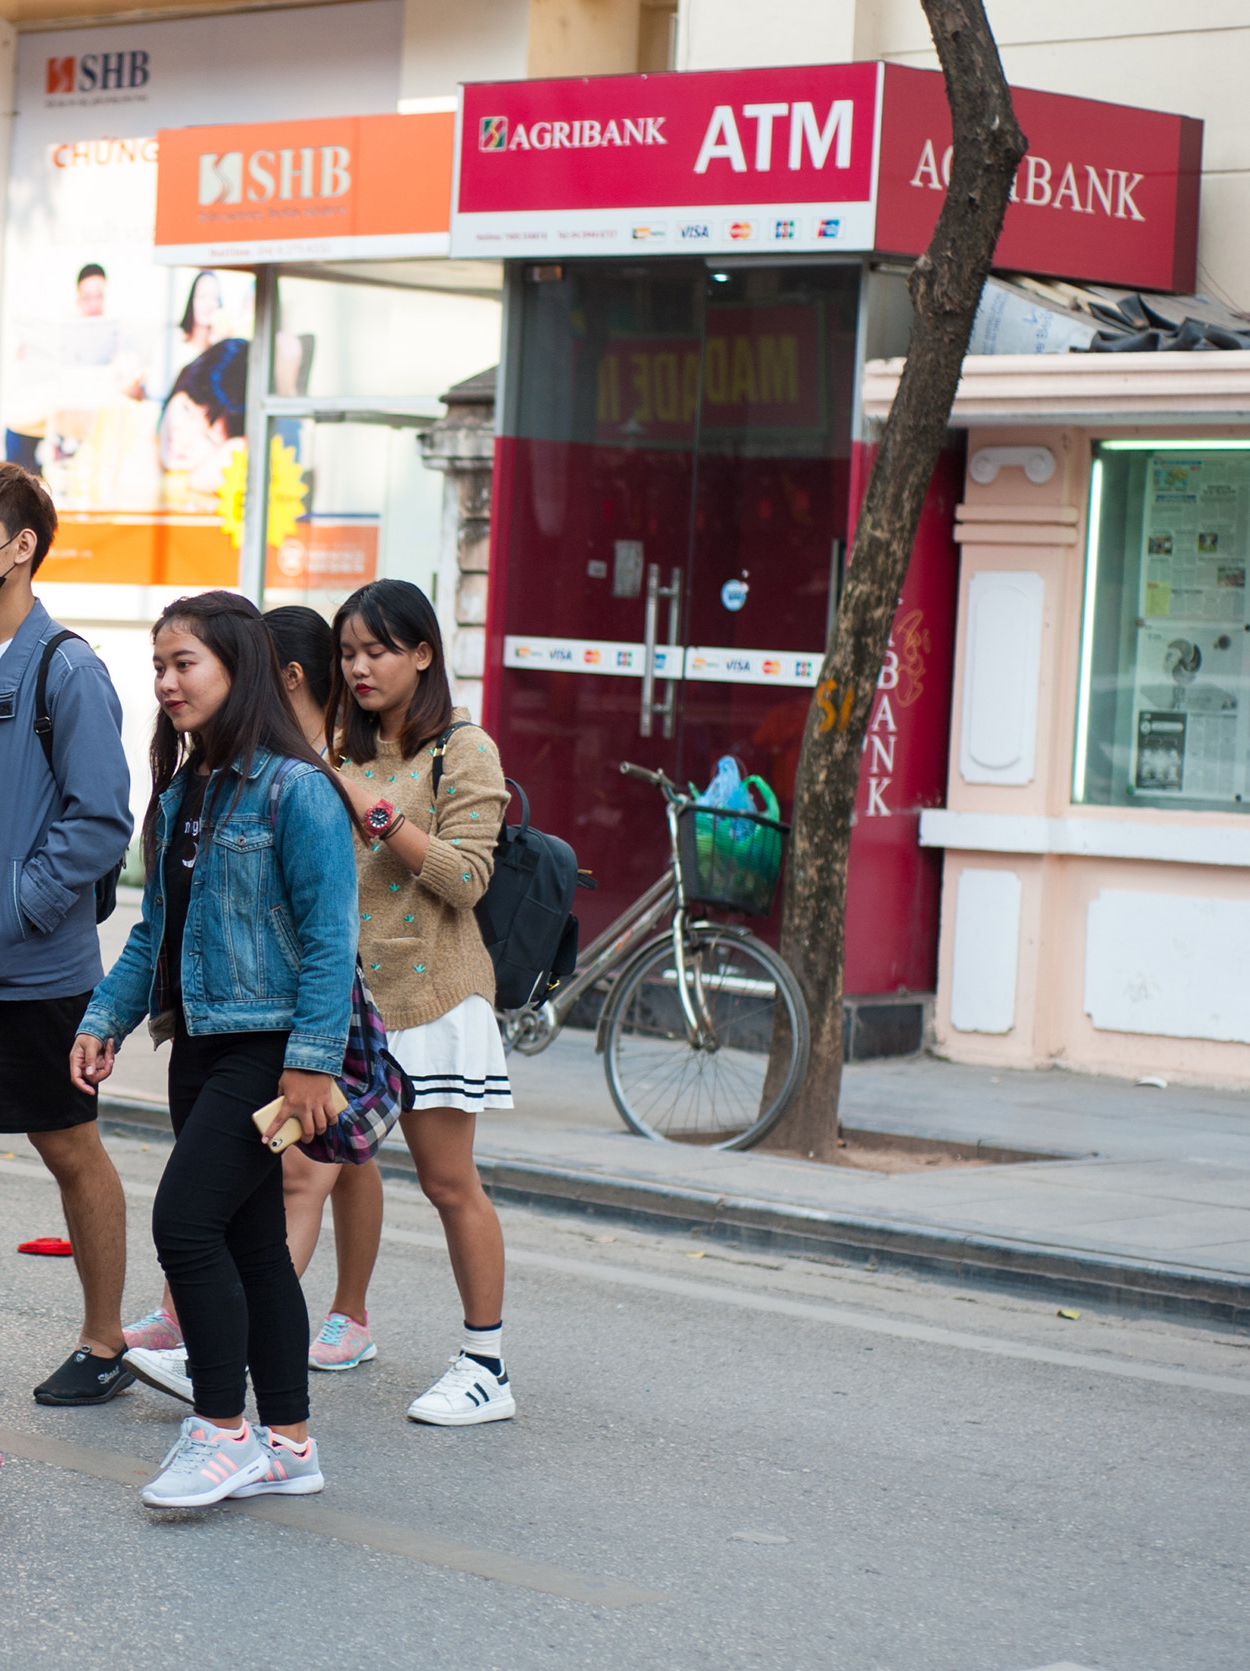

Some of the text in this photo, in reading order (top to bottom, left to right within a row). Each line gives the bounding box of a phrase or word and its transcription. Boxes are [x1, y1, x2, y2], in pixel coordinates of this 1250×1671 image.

[78, 50, 150, 92] SHB
[508, 117, 668, 150] AGRIBANK
[693, 99, 854, 175] ATM
[247, 145, 351, 202] SHB
[910, 138, 1146, 222] AIBANK
[679, 225, 709, 239] VISA
[549, 650, 573, 662] VISA
[725, 660, 751, 673] VISA
[864, 632, 900, 818] BANK
